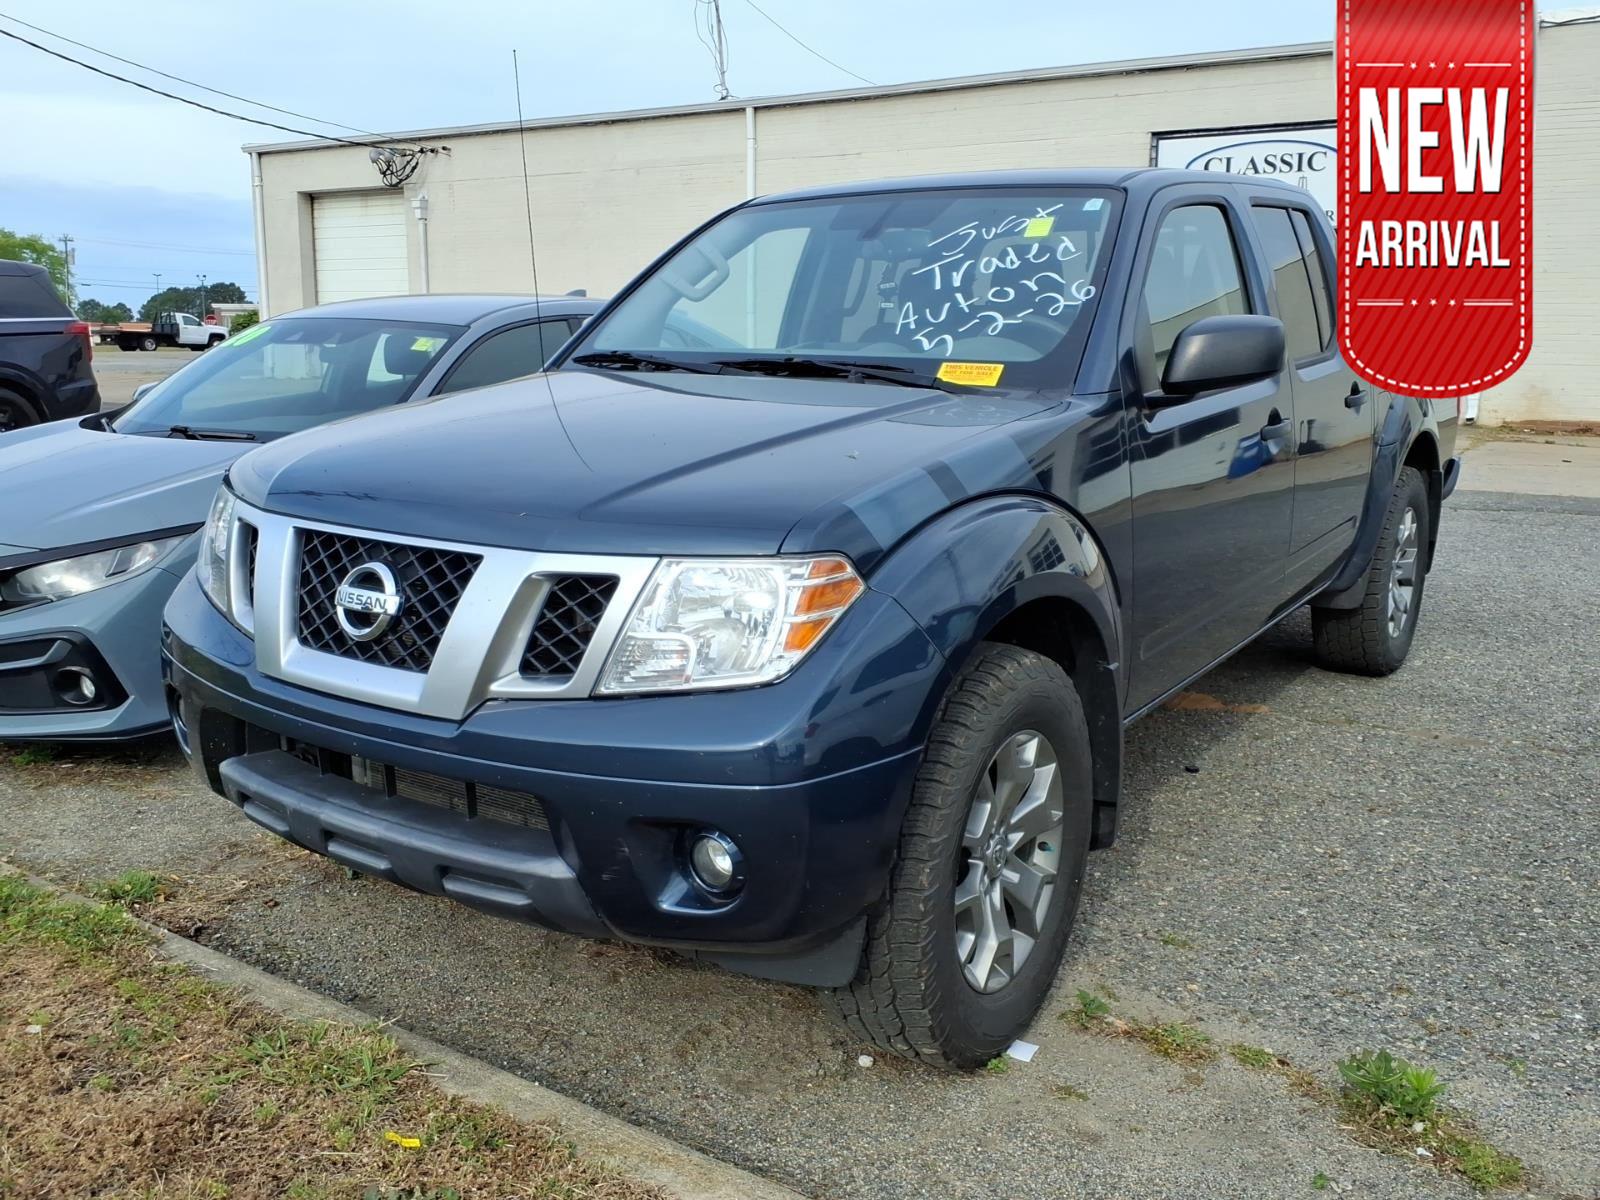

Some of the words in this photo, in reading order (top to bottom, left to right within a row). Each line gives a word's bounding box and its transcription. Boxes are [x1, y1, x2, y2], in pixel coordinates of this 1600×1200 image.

[1204, 151, 1328, 175] CLASSIC
[912, 236, 1082, 290] Traded
[912, 279, 1096, 356] 5-2-26
[337, 588, 387, 610] NISSAN
